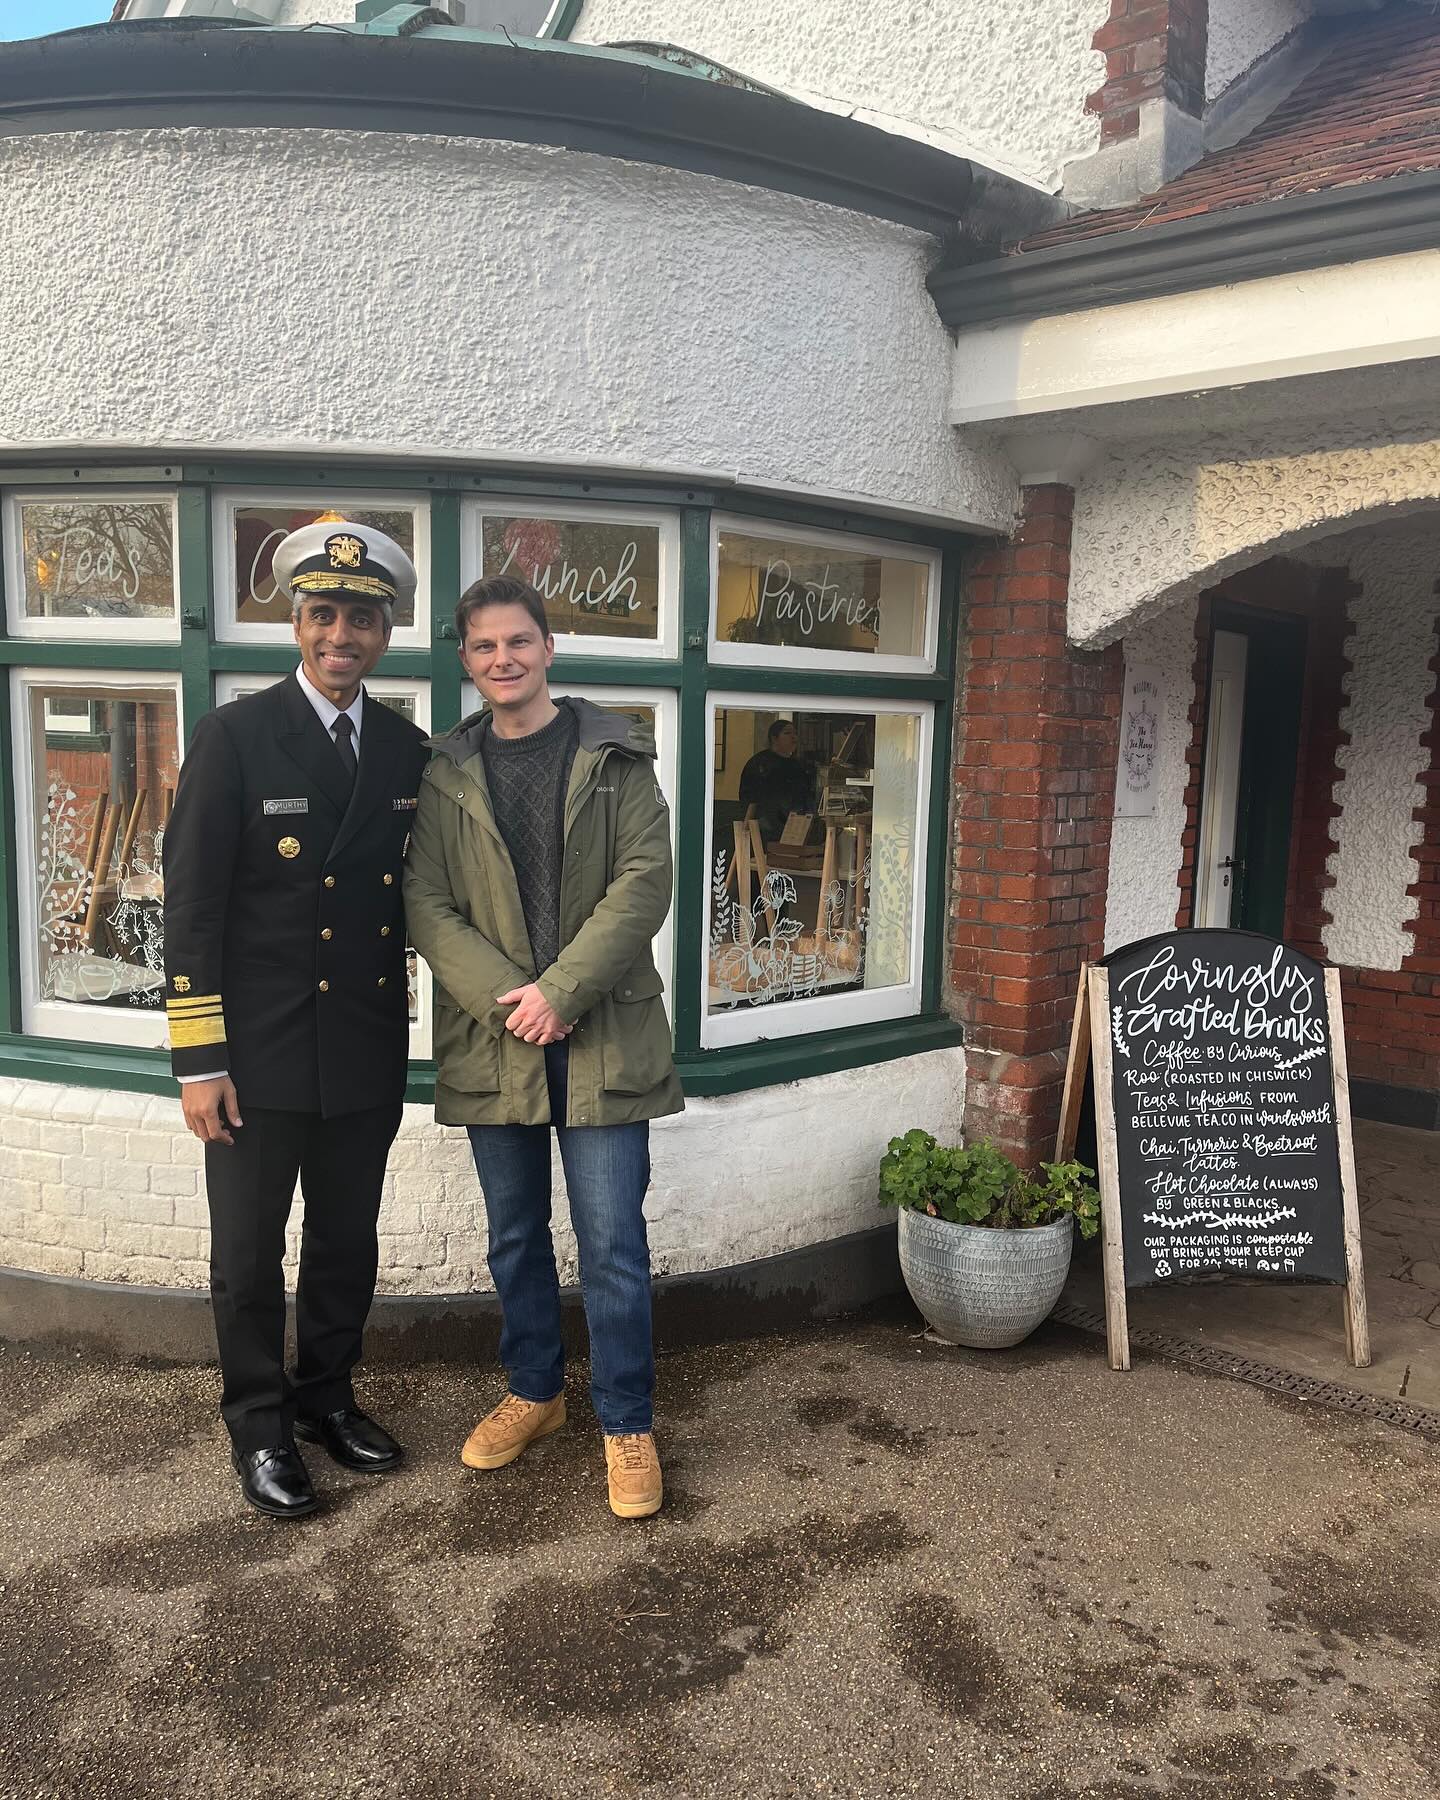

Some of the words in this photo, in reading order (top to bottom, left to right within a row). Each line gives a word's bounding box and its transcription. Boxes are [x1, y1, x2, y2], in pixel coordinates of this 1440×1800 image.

[40, 527, 141, 599] Teas
[276, 801, 306, 809] MURTHY
[1118, 945, 1315, 1014] Lovingly
[1127, 994, 1240, 1040] Crafted
[1244, 1007, 1325, 1045] Drinks
[1143, 1039, 1202, 1069] Coffee
[1228, 1041, 1282, 1061] Curious
[1123, 1069, 1160, 1086] Roo
[1164, 1071, 1224, 1087] (ROASTED
[1228, 1071, 1241, 1083] IN
[1246, 1067, 1311, 1082] CHISWICK)
[1186, 1090, 1254, 1112] Infusions
[1131, 1114, 1191, 1128] BELLEVUE
[1240, 1113, 1254, 1126] IN
[1178, 1136, 1239, 1153] Turmeric
[1252, 1133, 1317, 1157] Beetroot
[1145, 1171, 1186, 1194] Hot
[1189, 1173, 1259, 1195] Chocolate
[1263, 1176, 1318, 1191] (ALWAYS)
[1156, 1198, 1171, 1210] BY
[1183, 1197, 1220, 1209] GREEN
[1222, 1197, 1231, 1207] &
[1144, 1236, 1166, 1247] OUR
[1170, 1234, 1230, 1246] PACKAGING
[1232, 1234, 1242, 1245] IS
[1246, 1231, 1314, 1249] compostable
[1150, 1248, 1170, 1259] BUT
[1173, 1247, 1204, 1259] BRING
[1207, 1247, 1221, 1257] US
[1254, 1246, 1283, 1257] KEEP
[1284, 1246, 1305, 1257] CUP
[1179, 1258, 1200, 1268] FOR
